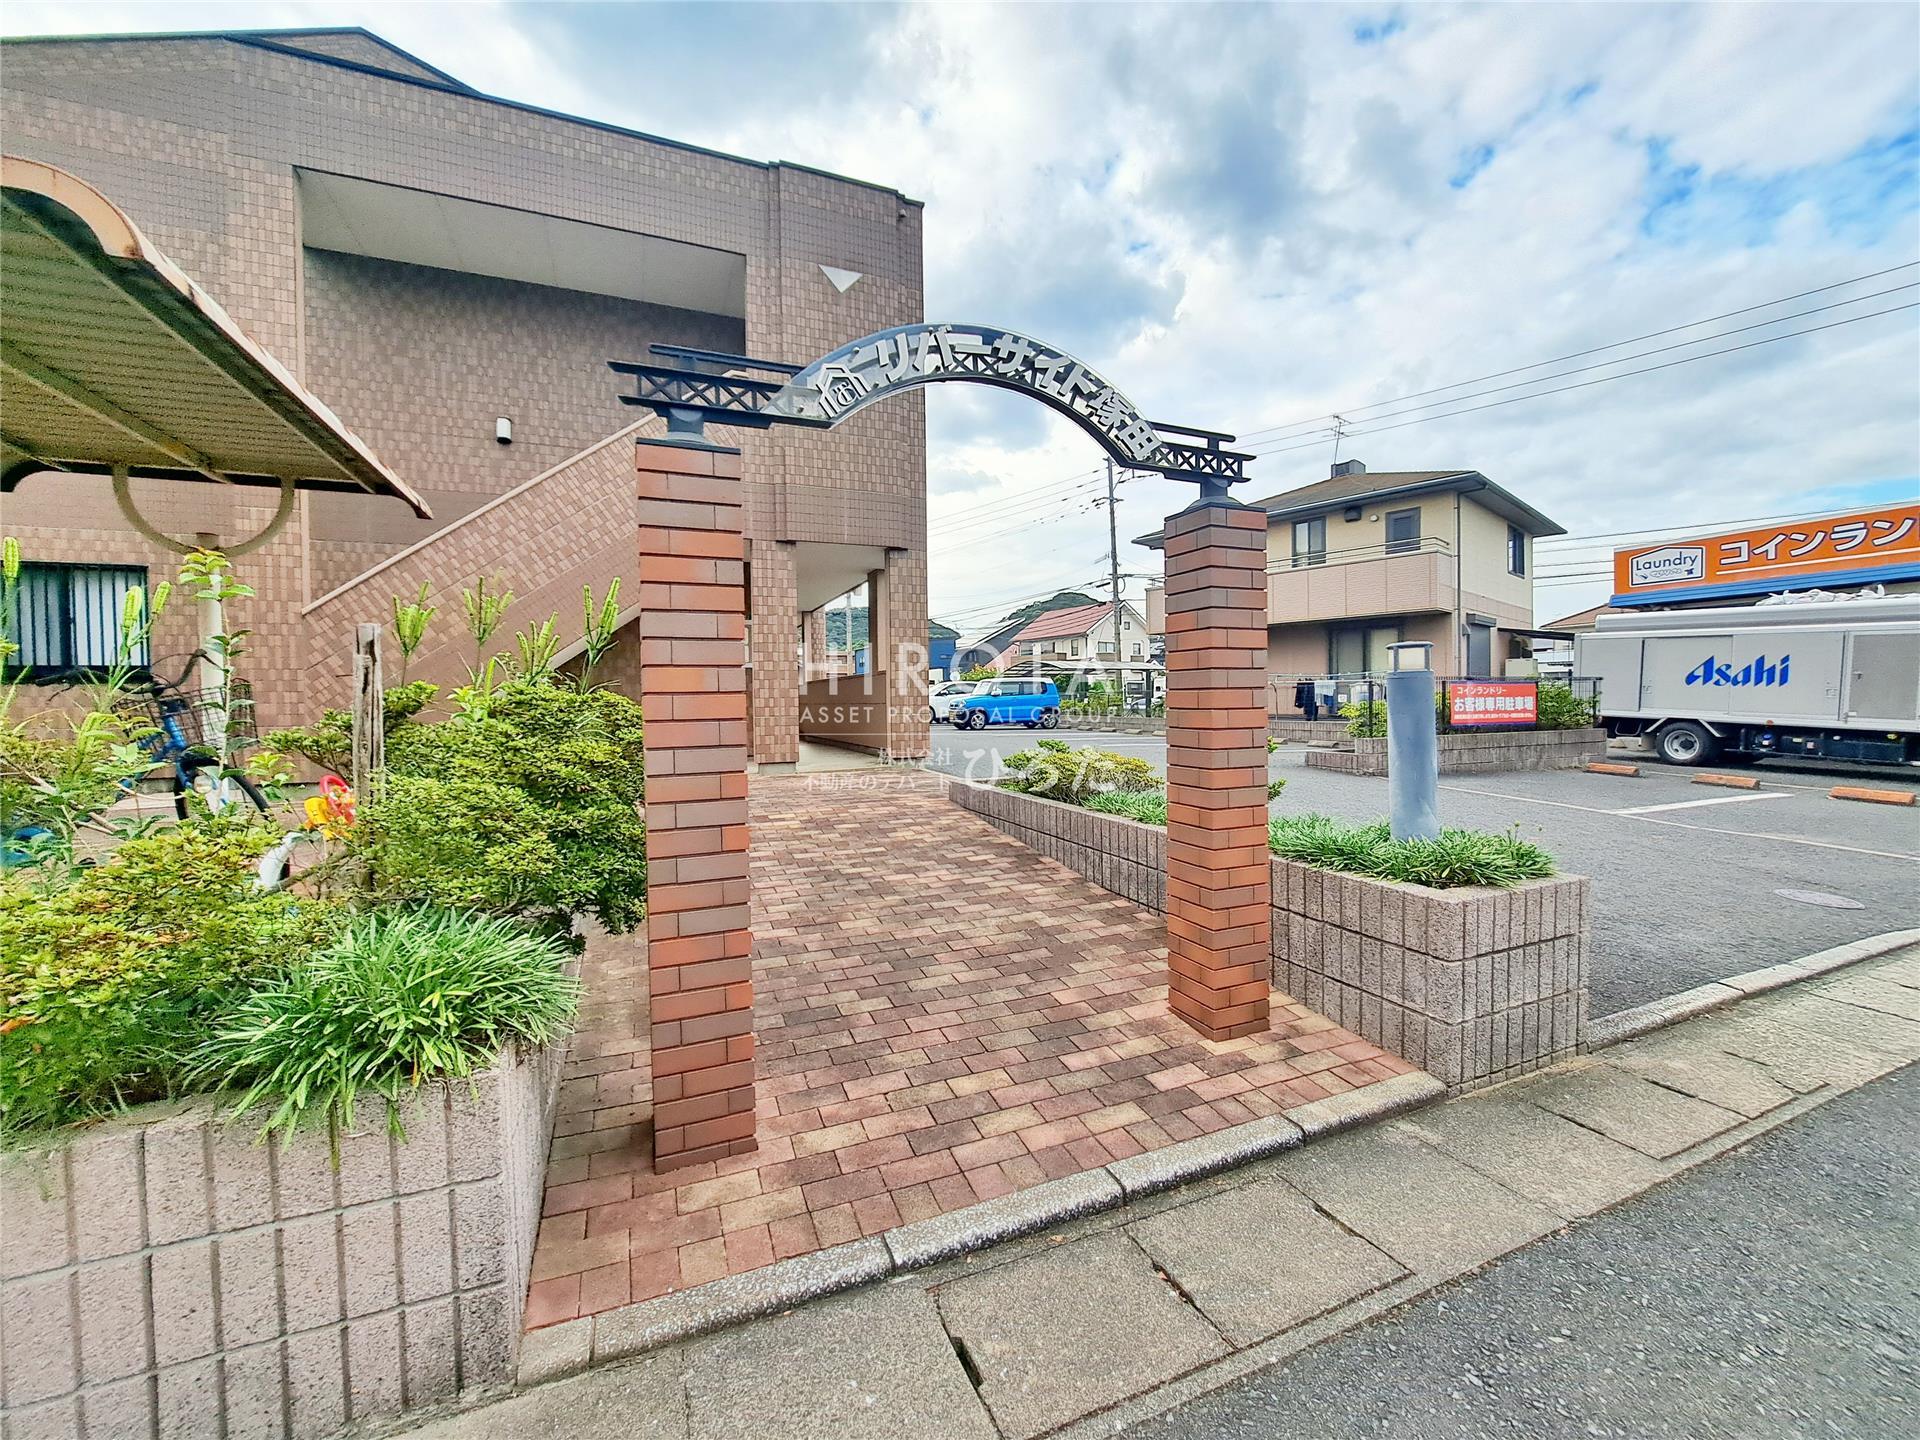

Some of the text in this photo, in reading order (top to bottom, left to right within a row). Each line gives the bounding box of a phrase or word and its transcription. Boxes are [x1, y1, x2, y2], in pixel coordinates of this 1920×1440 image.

[874, 325, 1162, 462] リバーサイド塚田
[1719, 516, 1920, 566] コインラン
[1636, 551, 1698, 571] Laundry
[1685, 654, 1790, 687] Asahi
[1457, 686, 1507, 695] コインランドリー
